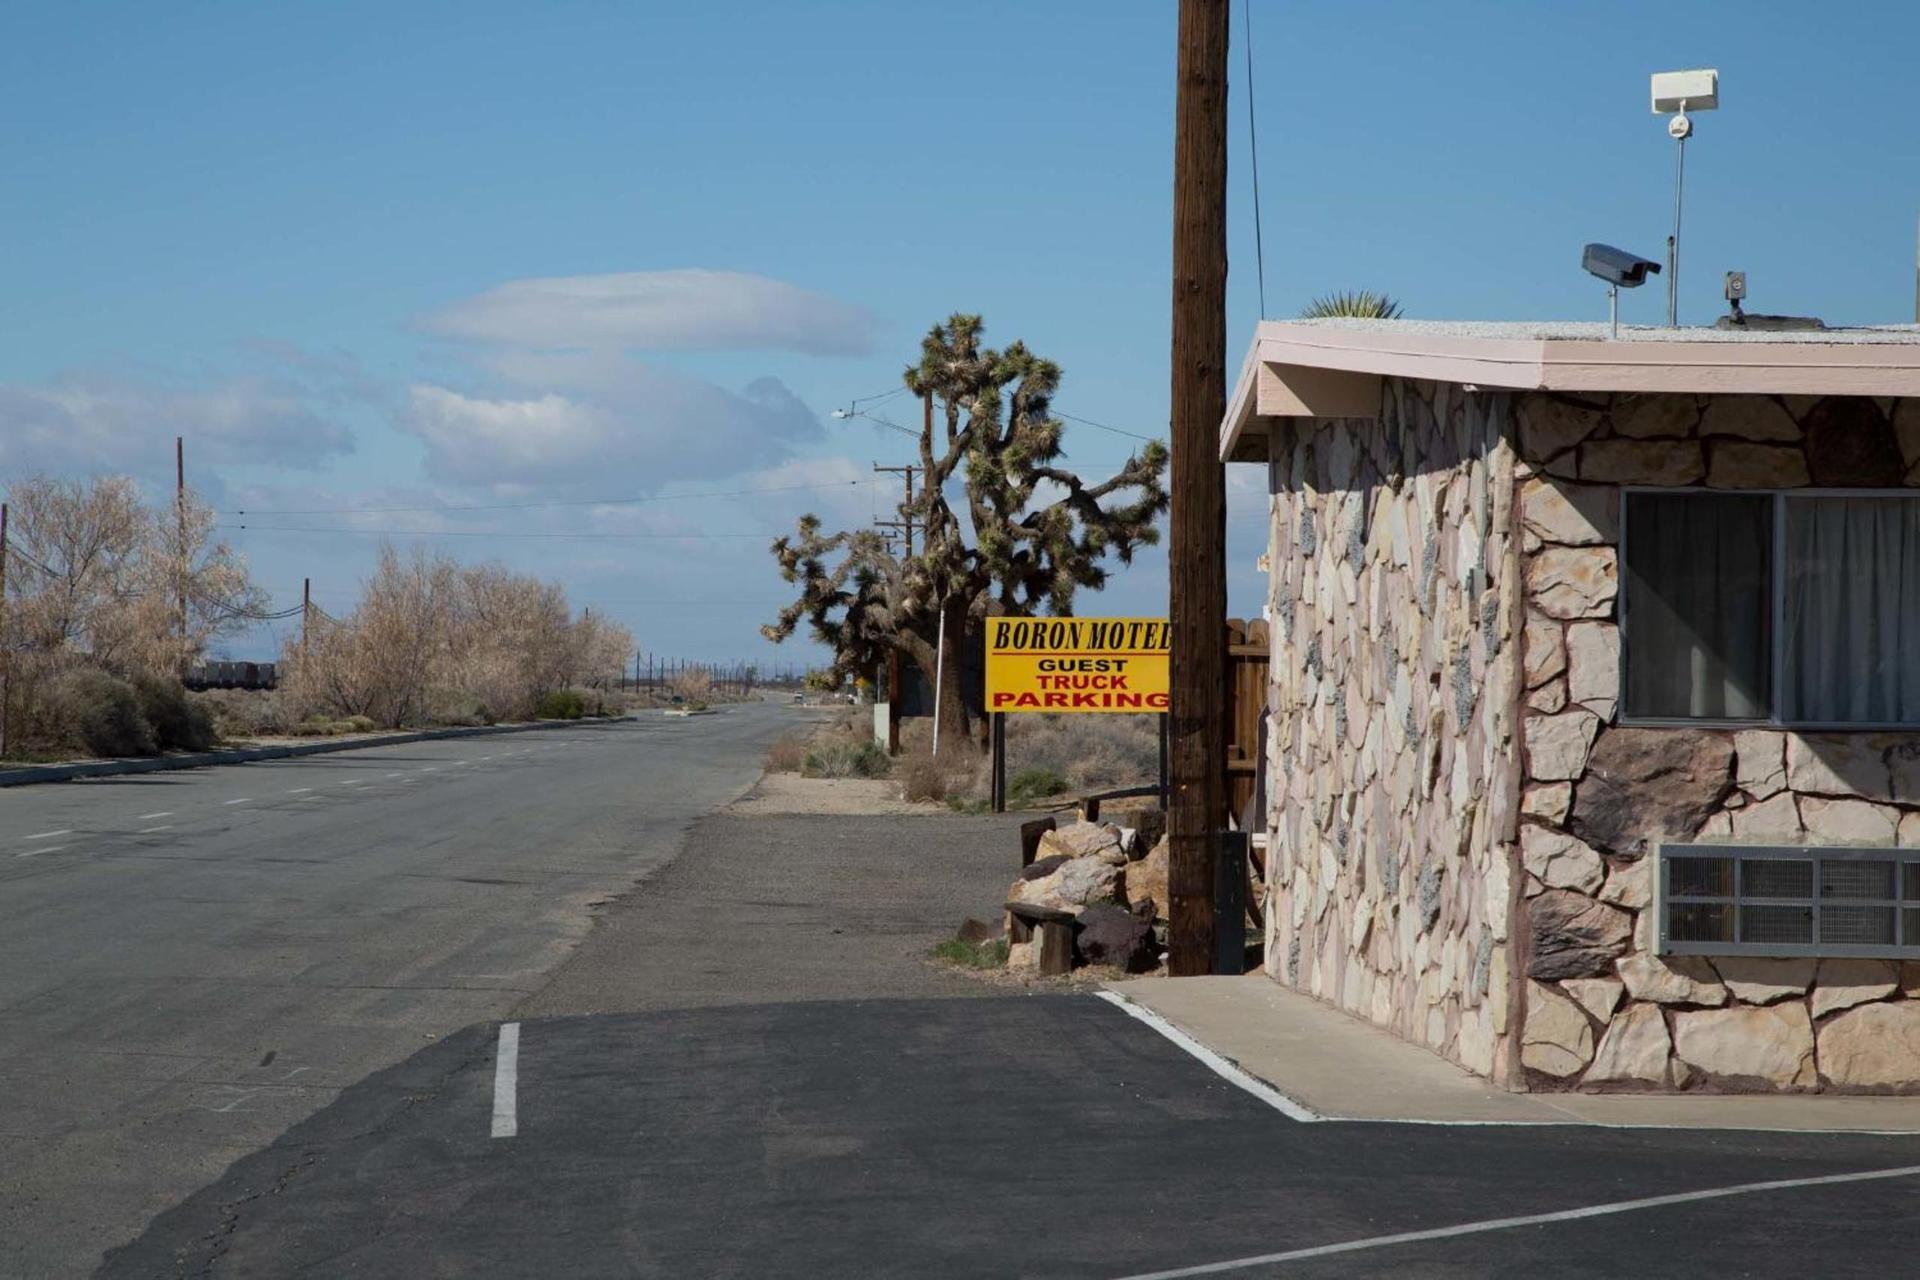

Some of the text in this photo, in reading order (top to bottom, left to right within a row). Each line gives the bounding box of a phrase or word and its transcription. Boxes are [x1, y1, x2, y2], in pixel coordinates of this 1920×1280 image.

[993, 621, 1084, 650] BORON
[1038, 659, 1128, 672] GUEST
[1036, 675, 1128, 689] TRUCK
[993, 692, 1169, 707] PARKING
